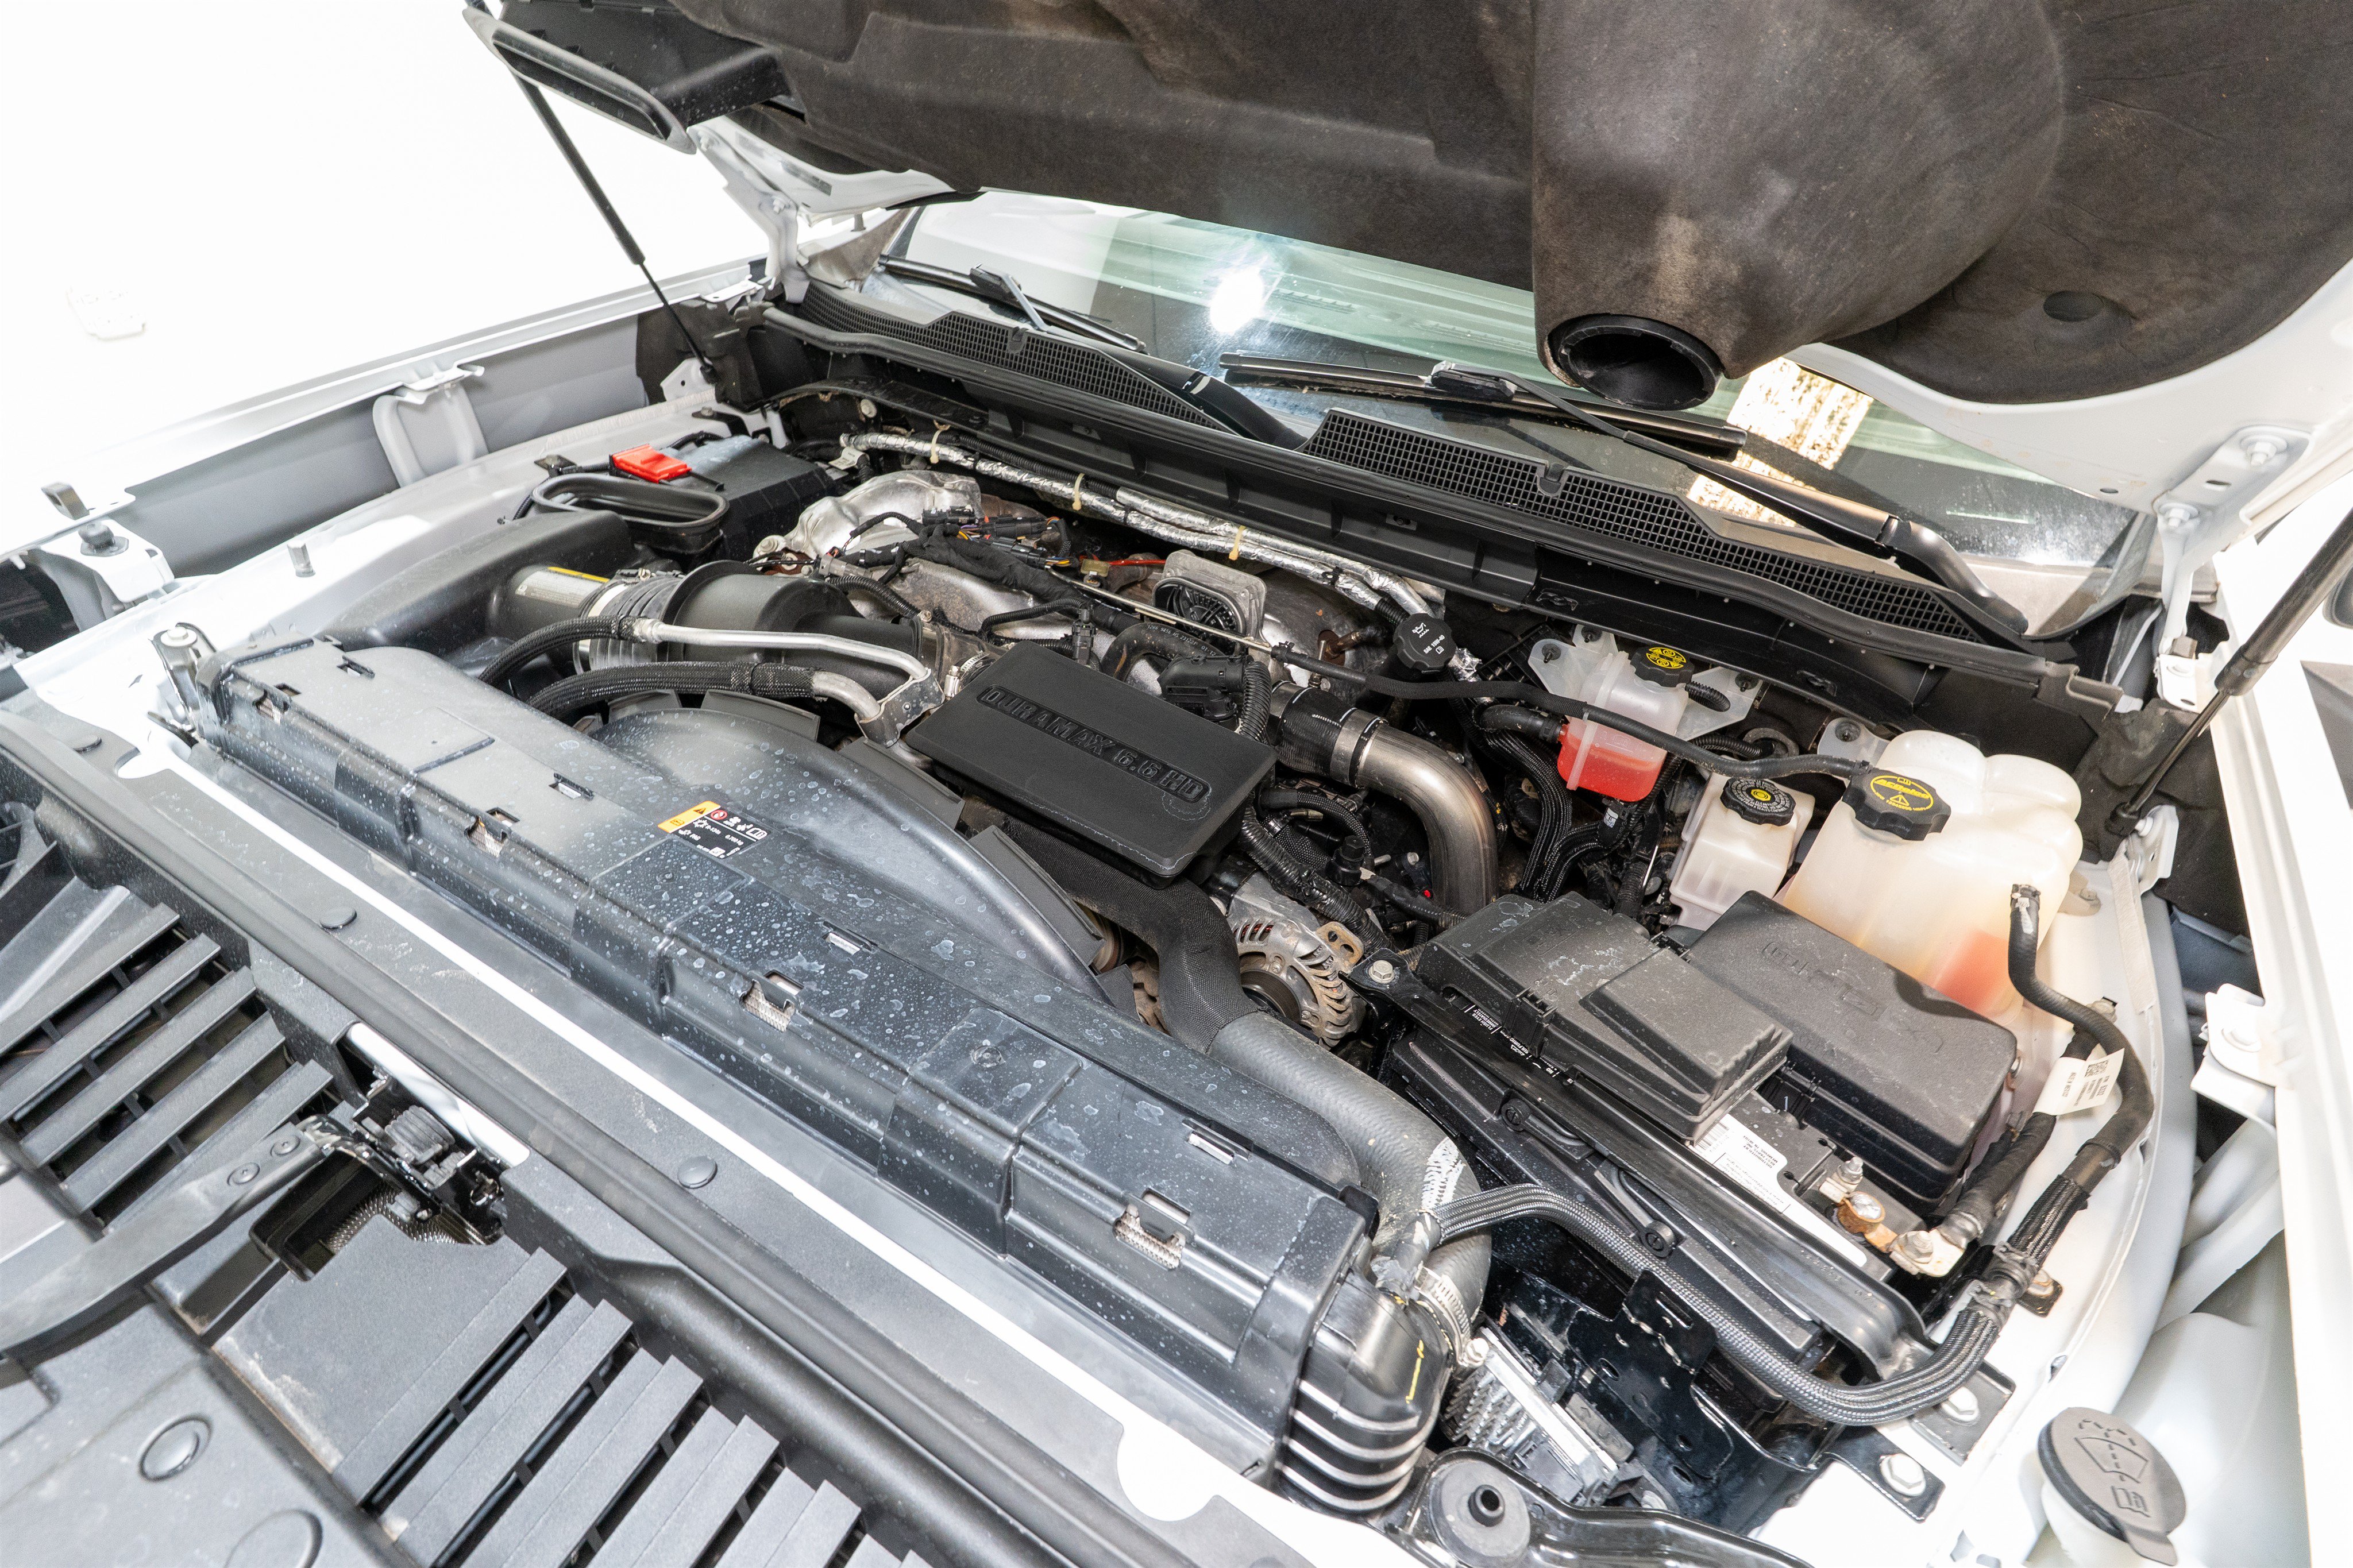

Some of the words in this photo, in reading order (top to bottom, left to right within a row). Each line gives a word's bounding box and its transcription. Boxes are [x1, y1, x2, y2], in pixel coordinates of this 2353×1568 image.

[1424, 646, 1432, 654] SAE
[1431, 635, 1445, 647] 15W-40
[980, 688, 1114, 755] DURAMAX
[1114, 748, 1162, 779] 6.6
[1159, 770, 1204, 797] HD
[1874, 779, 1930, 799] ACDelco
[1472, 1013, 1482, 1021] EYES
[1473, 1009, 1496, 1028] IMMEDIATELY
[1480, 1020, 1493, 1030] FLUSH
[1510, 1038, 1529, 1054] SULFURIC
